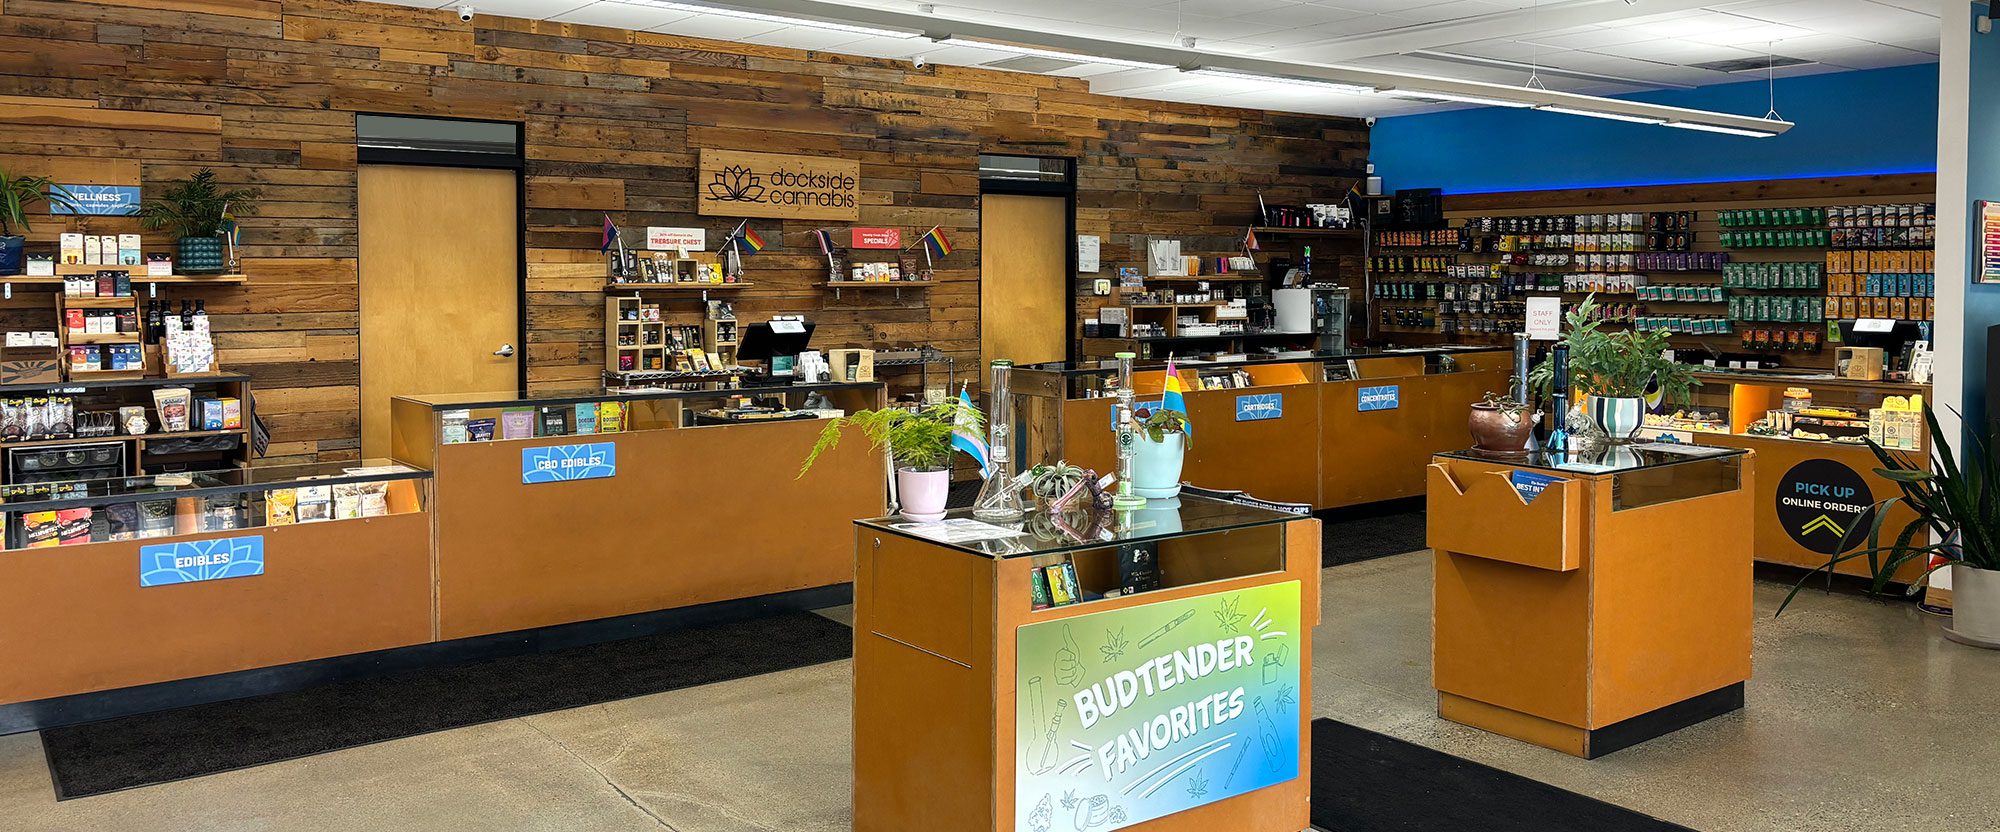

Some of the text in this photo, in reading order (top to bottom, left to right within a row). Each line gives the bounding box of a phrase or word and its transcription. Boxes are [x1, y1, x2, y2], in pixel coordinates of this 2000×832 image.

[771, 168, 855, 191] dockside
[70, 192, 121, 202] WELLNESS
[769, 189, 855, 208] cannabis
[863, 237, 888, 245] SPECIALS
[1360, 393, 1396, 403] CONCENTRATES
[1243, 402, 1275, 412] CARTRIDGES
[538, 456, 602, 470] CBD EDIBLES
[1516, 483, 1532, 491] BEST
[1795, 482, 1855, 498] PICK UP
[1782, 496, 1822, 509] ONLINE
[175, 553, 230, 569] EDIBLES
[1073, 635, 1255, 730] BUDTENDER
[1097, 686, 1245, 782] FAVORITES
